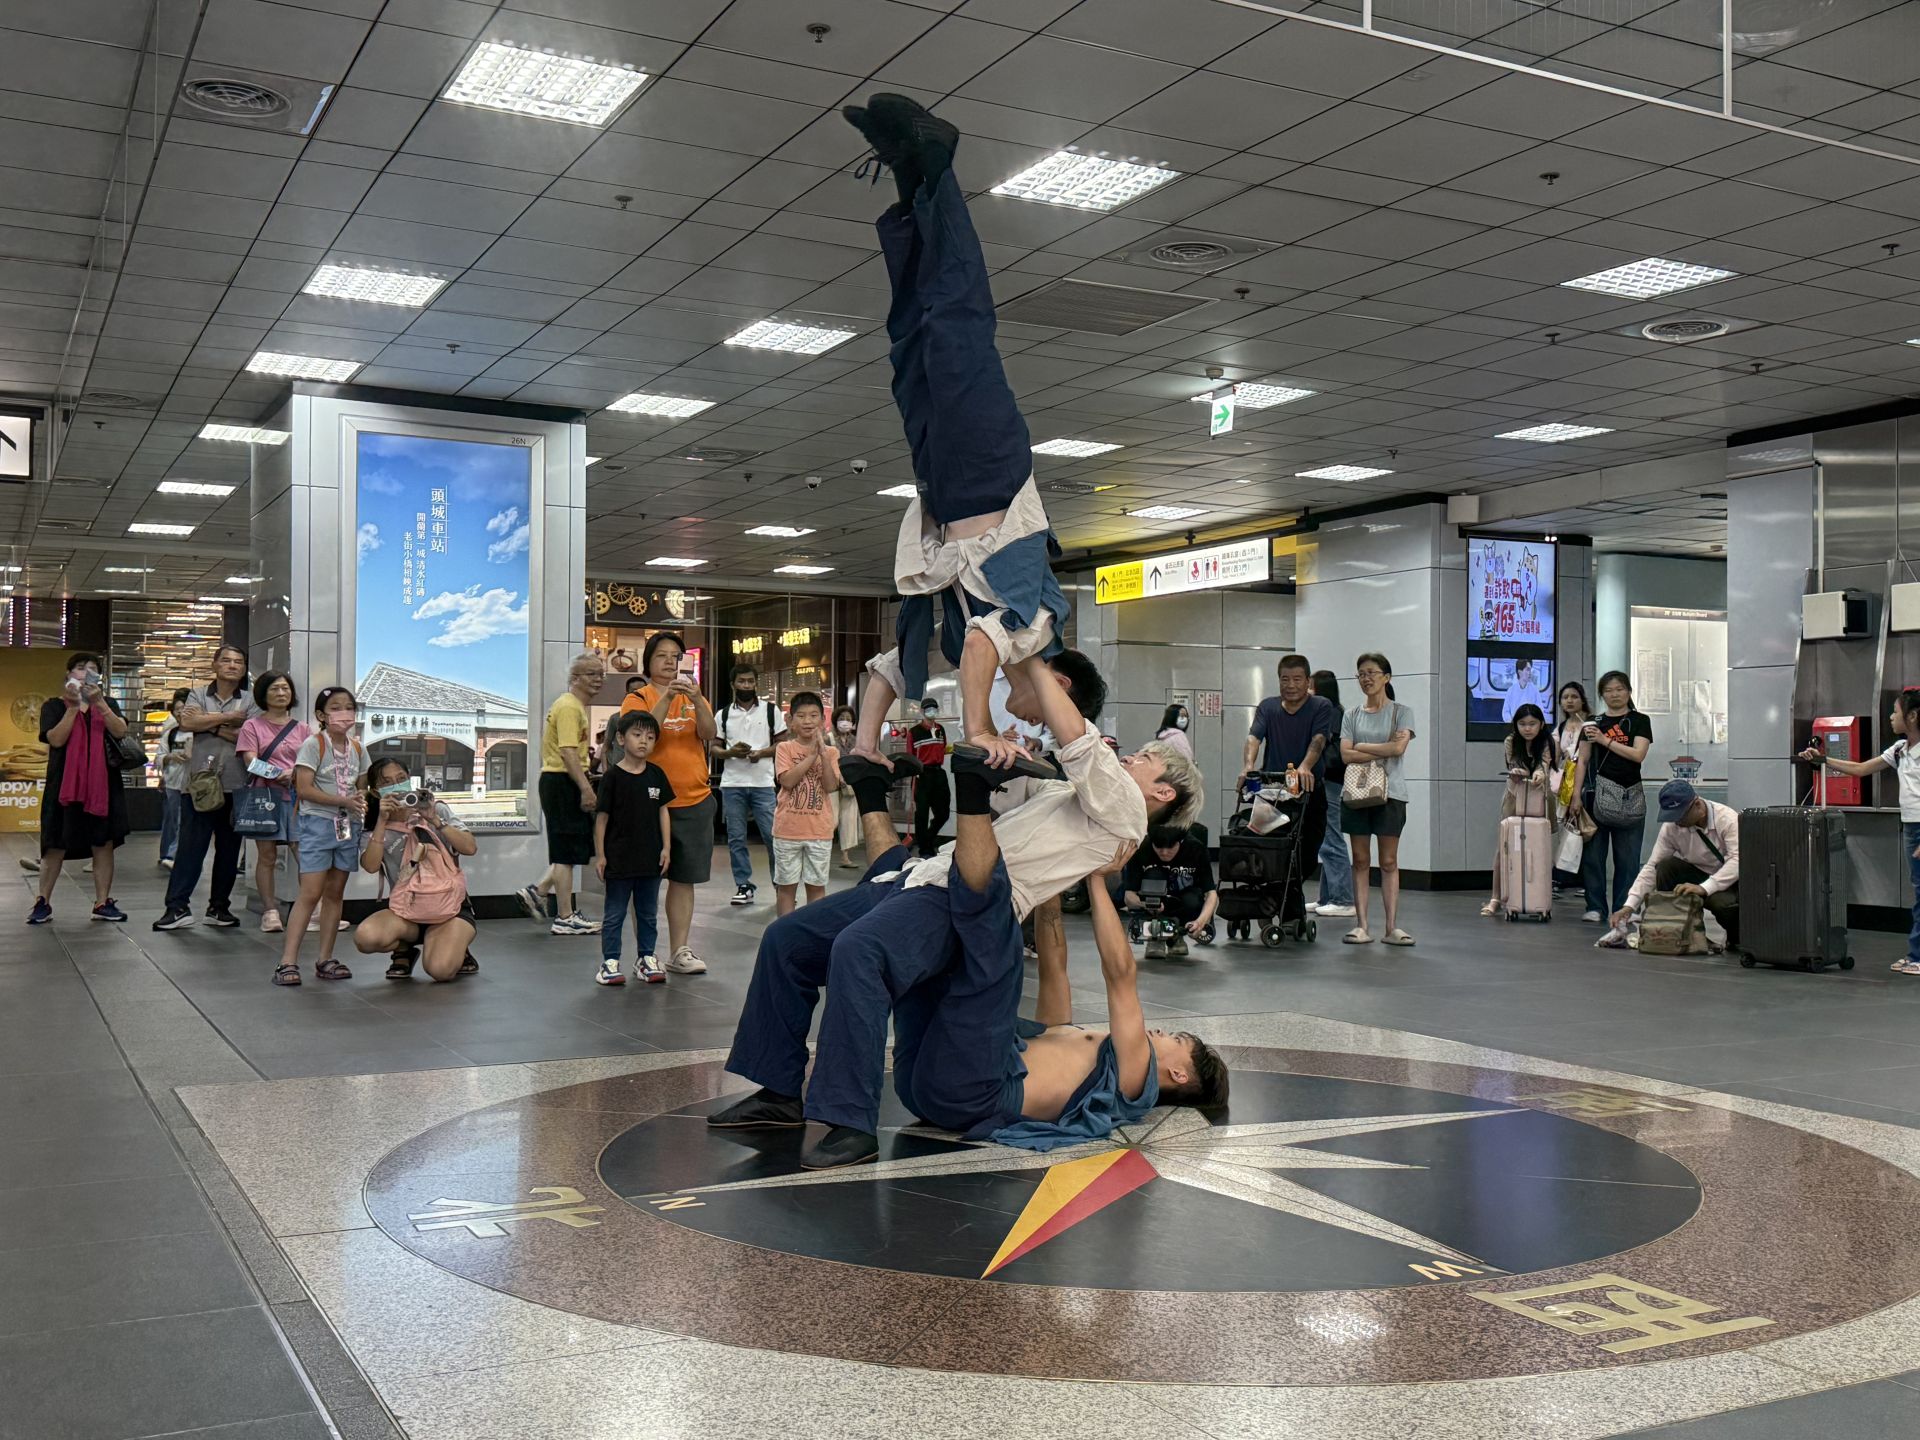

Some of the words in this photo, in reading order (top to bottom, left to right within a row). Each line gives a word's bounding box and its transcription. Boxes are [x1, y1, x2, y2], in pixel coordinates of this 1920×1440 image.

[511, 437, 526, 445] 26N
[431, 488, 446, 553] 頭城車站
[403, 531, 413, 605] 老街小橋相映成趣
[416, 560, 426, 597] 清水紅磚
[1494, 602, 1516, 634] 165
[0, 781, 33, 795] ppy
[36, 779, 46, 792] E
[406, 1186, 607, 1239] 北
[649, 1196, 706, 1211] N
[1408, 1261, 1485, 1281] W
[1466, 1273, 1778, 1354] 西
